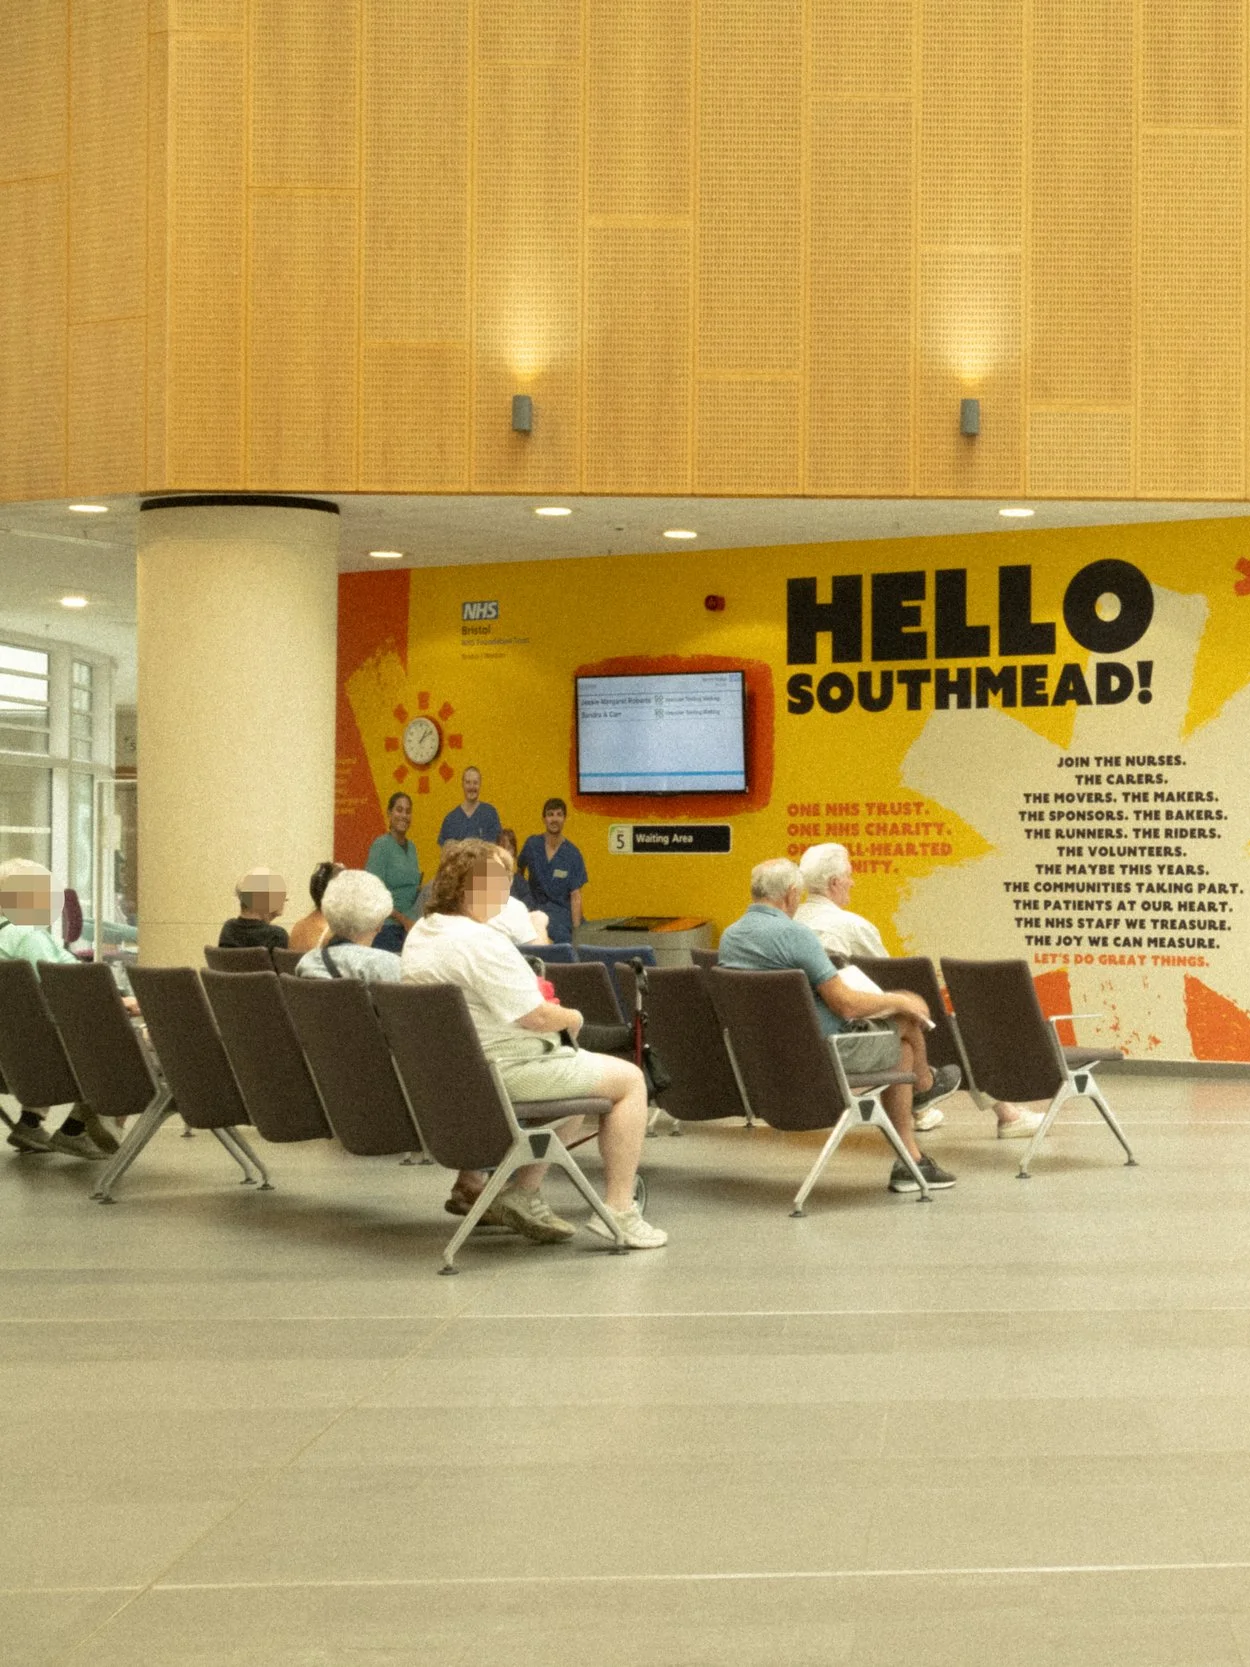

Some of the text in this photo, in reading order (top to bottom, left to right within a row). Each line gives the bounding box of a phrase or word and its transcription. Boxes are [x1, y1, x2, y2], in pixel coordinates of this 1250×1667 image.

[463, 602, 498, 619] NHS
[787, 558, 1154, 665] HELLO
[787, 660, 1154, 714] SOUTHMEAD!
[1057, 755, 1186, 768] JOIN THE NURSES.
[1075, 773, 1168, 785] THE CARERS.
[1023, 791, 1219, 804] THE MOVERS. THE MAKERS.
[787, 801, 930, 817] ONE NHS TRUST.
[1018, 809, 1228, 821] THE SPONSORS. THE BAKERS.
[787, 822, 951, 836] ONE NHS CHARITY.
[1024, 828, 1221, 839] THE RUNNERS. THE RIDERS.
[616, 834, 625, 849] 5
[636, 833, 693, 845] Waiting Area
[1057, 846, 1187, 857] THE VOLUNTEERS.
[1035, 864, 1210, 876] THE MAYBE THIS YEARS.
[1003, 882, 1244, 894] THE COMMUNITIES TAKING PART.
[1013, 900, 1233, 913] THE PATIENTS AT OUR HEART.
[1015, 918, 1231, 931] THE NHS STAFF WE TREASURE.
[1025, 935, 1220, 949] THE JOY WE CAN MEASURE.
[1034, 953, 1210, 967] LET'S DO GREAT THINGS.
